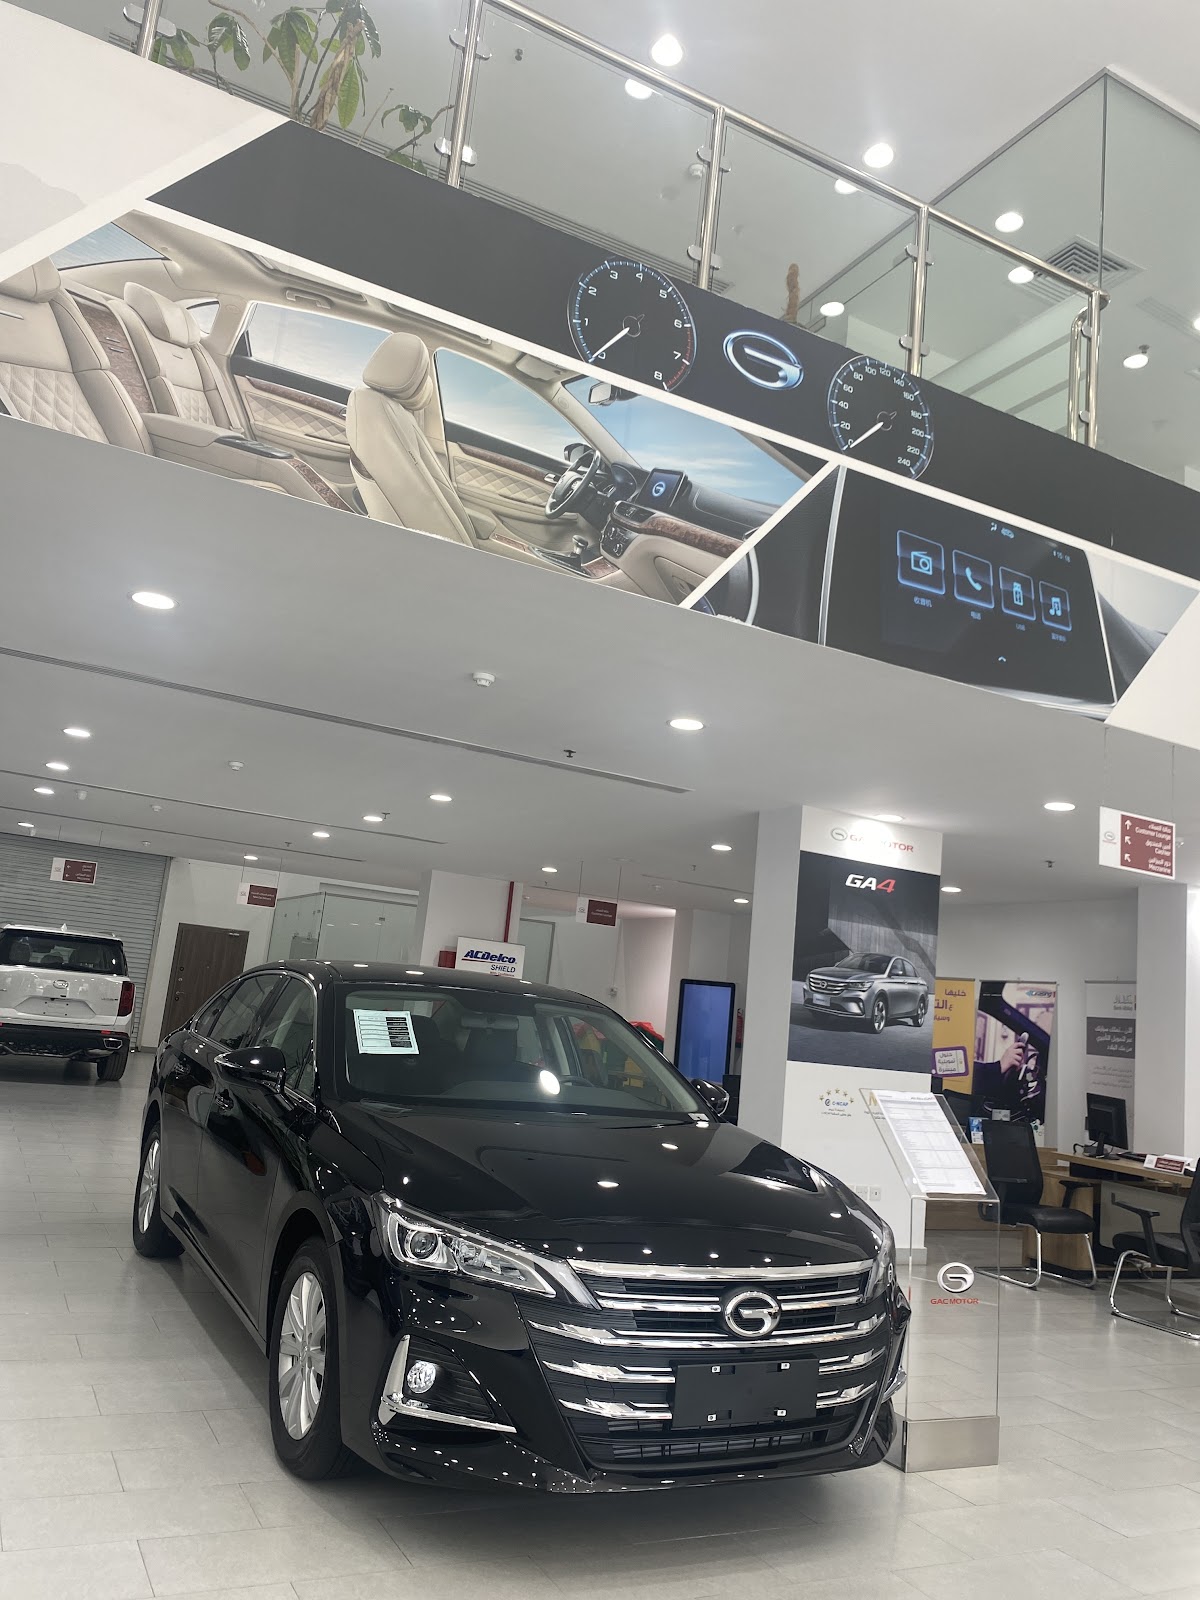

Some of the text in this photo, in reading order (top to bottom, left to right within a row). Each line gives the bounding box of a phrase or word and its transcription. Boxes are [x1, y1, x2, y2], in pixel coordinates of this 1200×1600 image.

[610, 270, 618, 280] 3
[636, 272, 643, 282] 4
[588, 286, 597, 296] 2
[659, 289, 667, 299] 5
[584, 317, 588, 326] 1
[674, 319, 682, 328] 6
[673, 351, 681, 360] 7
[654, 371, 662, 380] 8
[865, 366, 877, 376] 100
[880, 367, 891, 377] 120
[853, 372, 863, 381] 80
[893, 377, 905, 387] 140
[843, 383, 853, 393] 60
[838, 401, 849, 410] 40
[840, 421, 850, 430] 20
[912, 428, 924, 437] 200
[907, 445, 920, 455] 220
[897, 457, 911, 466] 240
[845, 873, 896, 893] GA4
[463, 950, 516, 964] ACDelco
[490, 964, 516, 973] SHIELD
